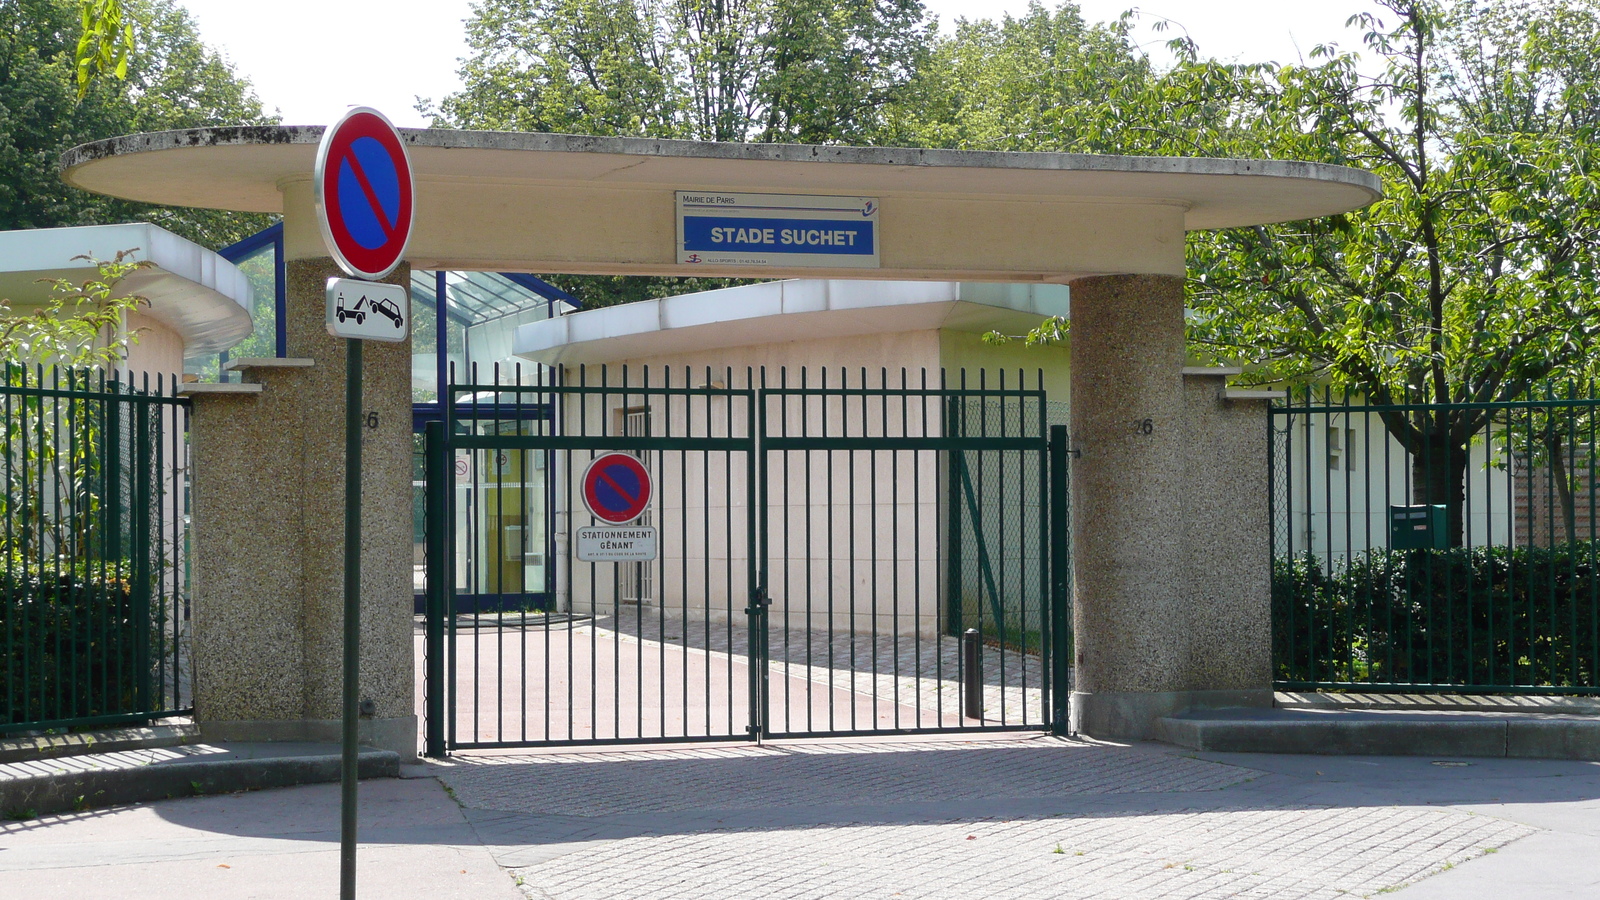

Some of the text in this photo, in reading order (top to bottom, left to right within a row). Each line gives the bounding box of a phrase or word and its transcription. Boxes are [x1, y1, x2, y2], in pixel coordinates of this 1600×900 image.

[710, 227, 857, 246] STADE SUCHET
[1133, 418, 1153, 435] 26
[581, 531, 652, 540] STATIONNEMENT
[600, 540, 634, 550] GÊNANT
